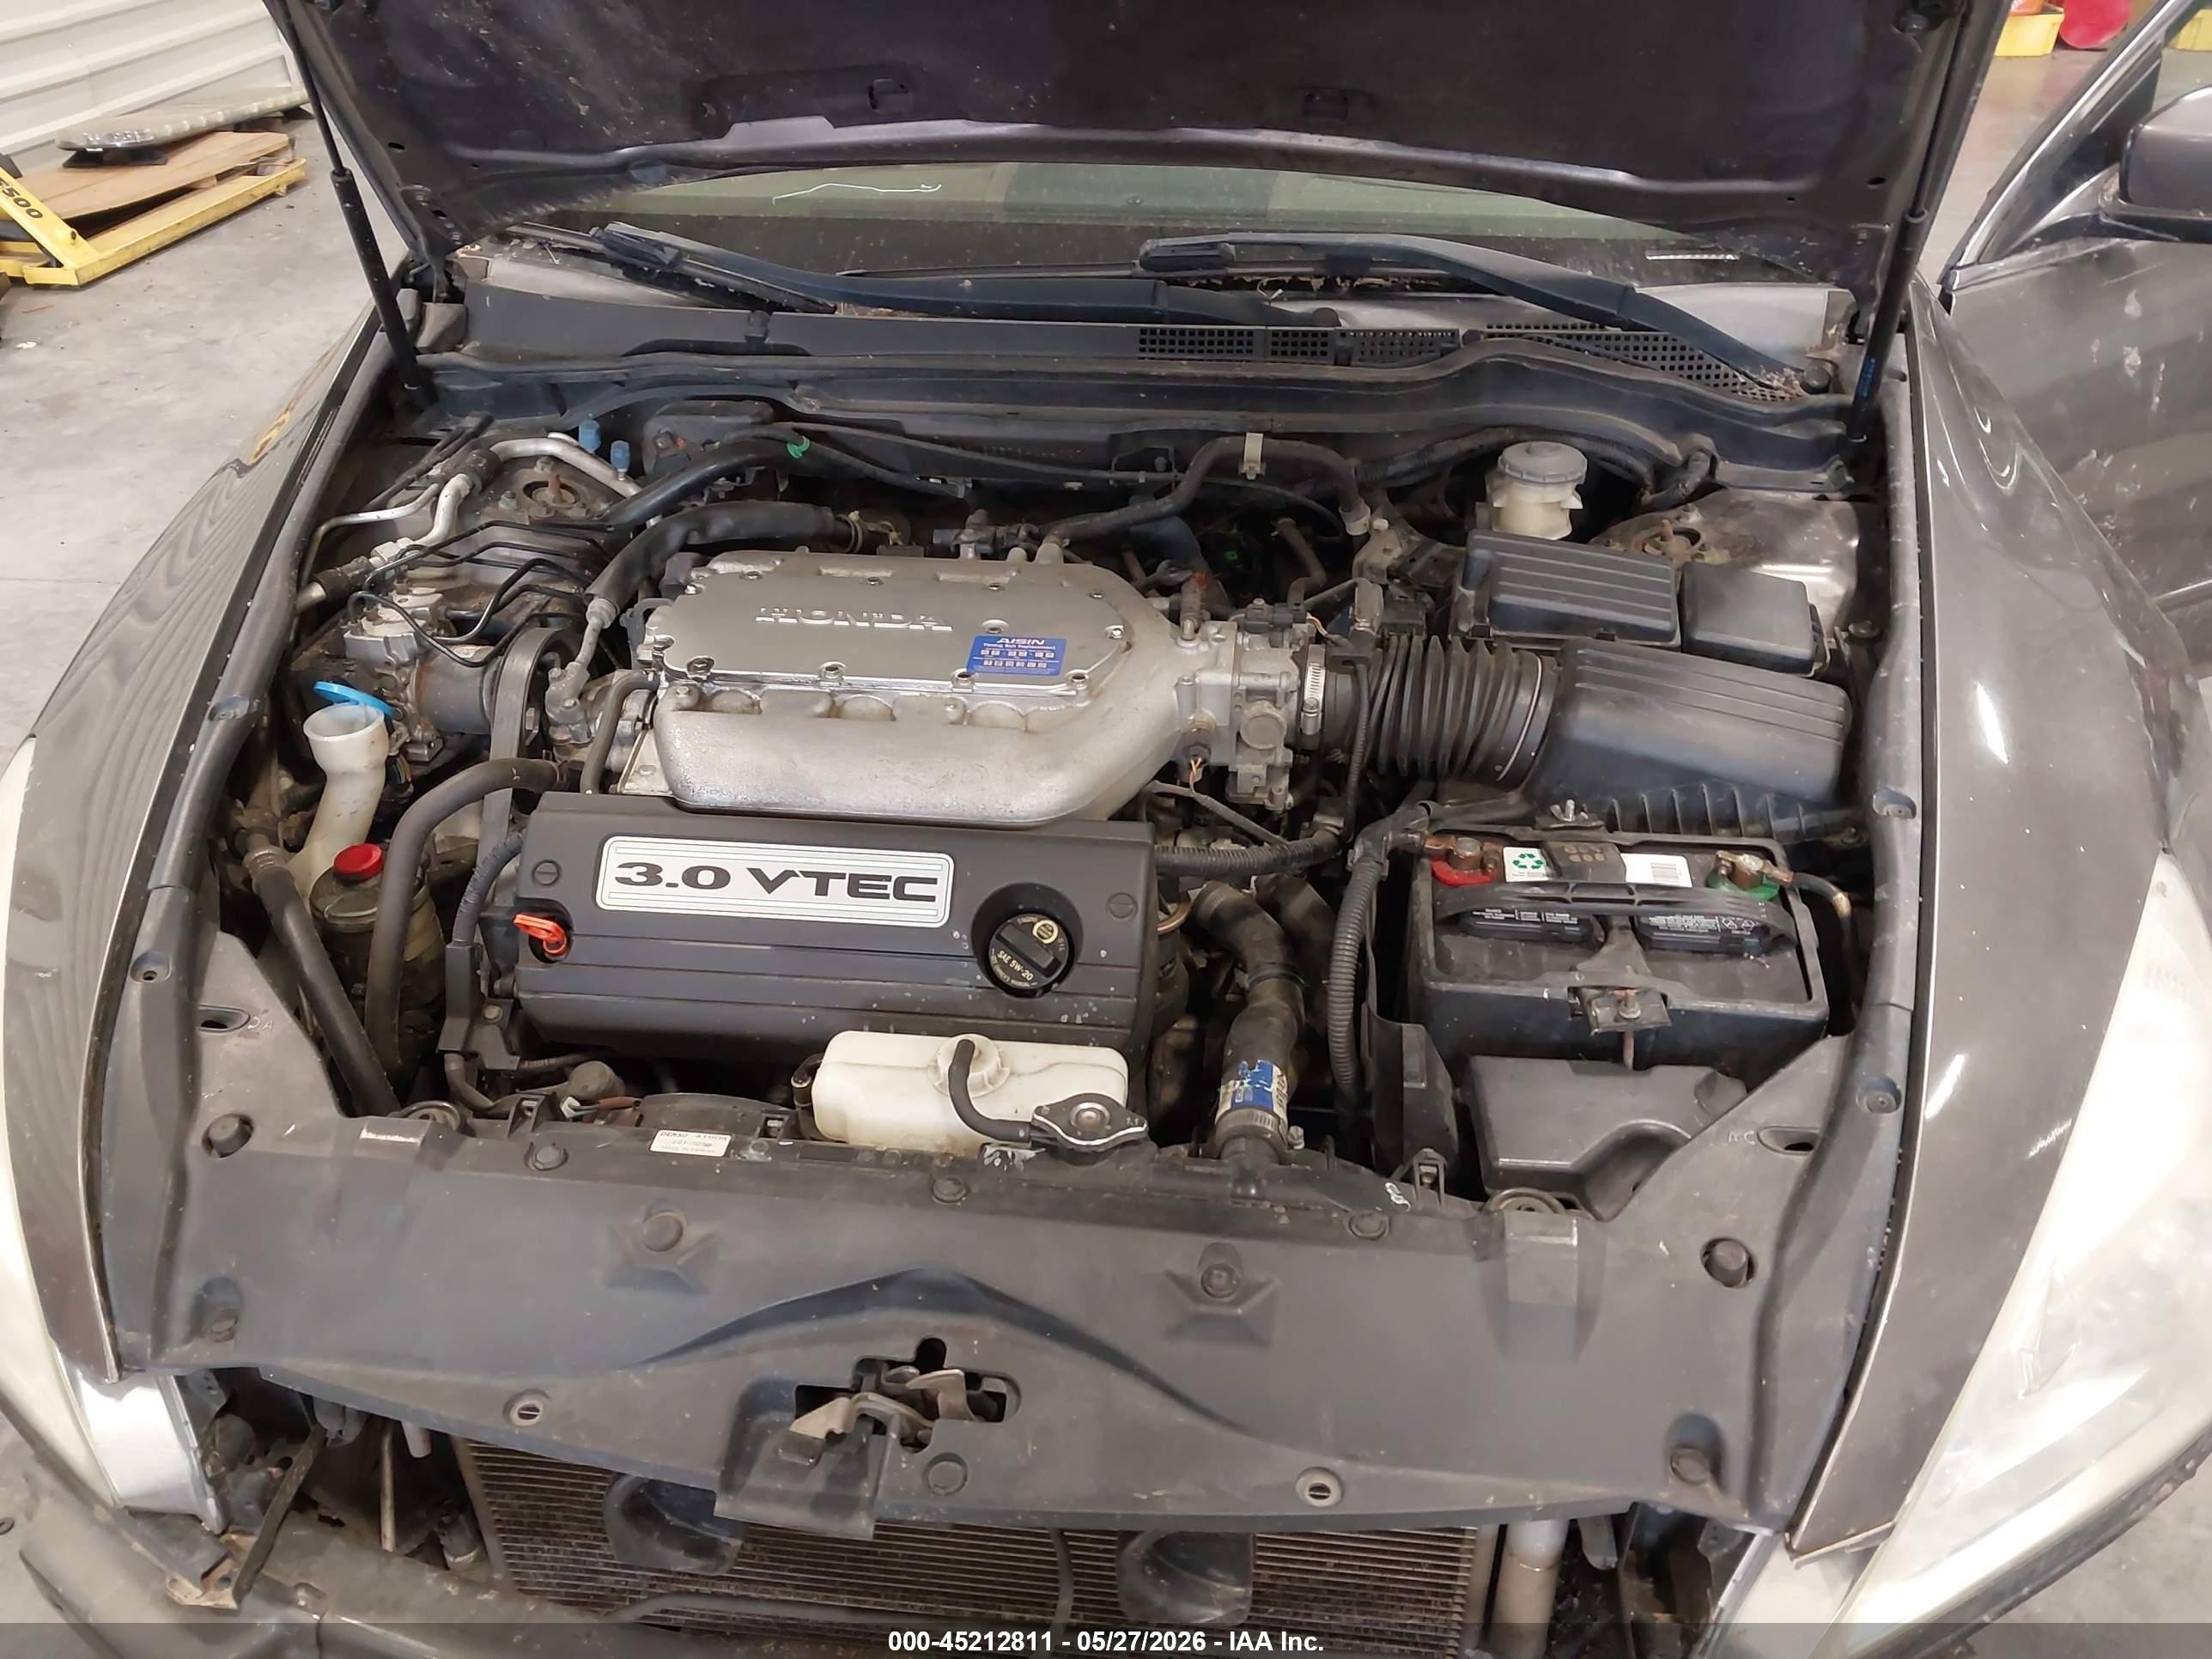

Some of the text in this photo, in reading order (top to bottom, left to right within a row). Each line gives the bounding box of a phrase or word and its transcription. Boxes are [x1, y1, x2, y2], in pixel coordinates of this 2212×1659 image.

[755, 606, 952, 631] HONDA
[614, 861, 939, 903] 3.0 VTEC
[997, 950, 1034, 981] SAE 5W-20
